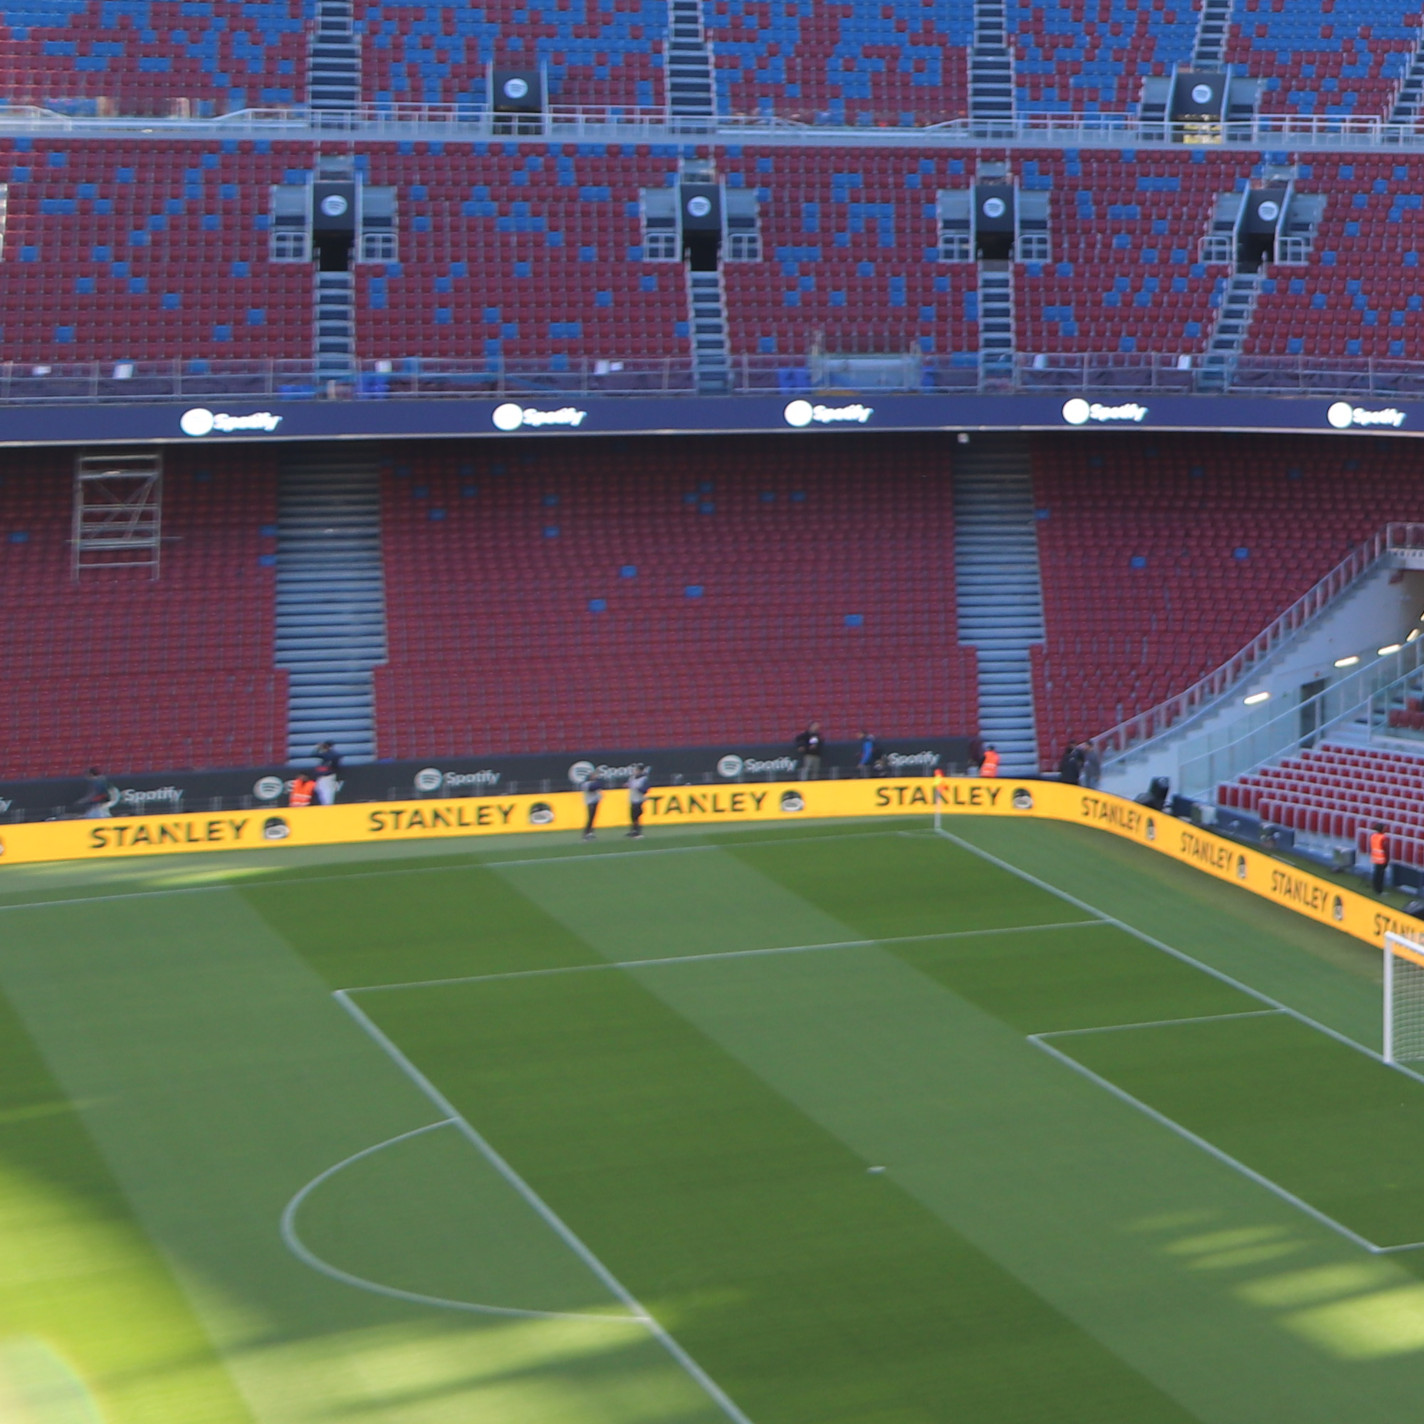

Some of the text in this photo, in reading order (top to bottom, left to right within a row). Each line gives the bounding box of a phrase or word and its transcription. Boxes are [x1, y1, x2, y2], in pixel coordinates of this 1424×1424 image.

[1352, 407, 1406, 427] Spotify
[744, 756, 797, 772] Spotify
[445, 769, 501, 785] Spotify
[123, 786, 184, 804] Spotify
[646, 791, 768, 816] TANLEY
[876, 786, 1001, 807] STANLEY
[369, 804, 516, 832] STANLEY
[1081, 796, 1142, 831] STANLEY
[90, 818, 250, 849] STANLEY
[1180, 832, 1233, 871] STANLEY
[1271, 870, 1328, 912] STANLEY
